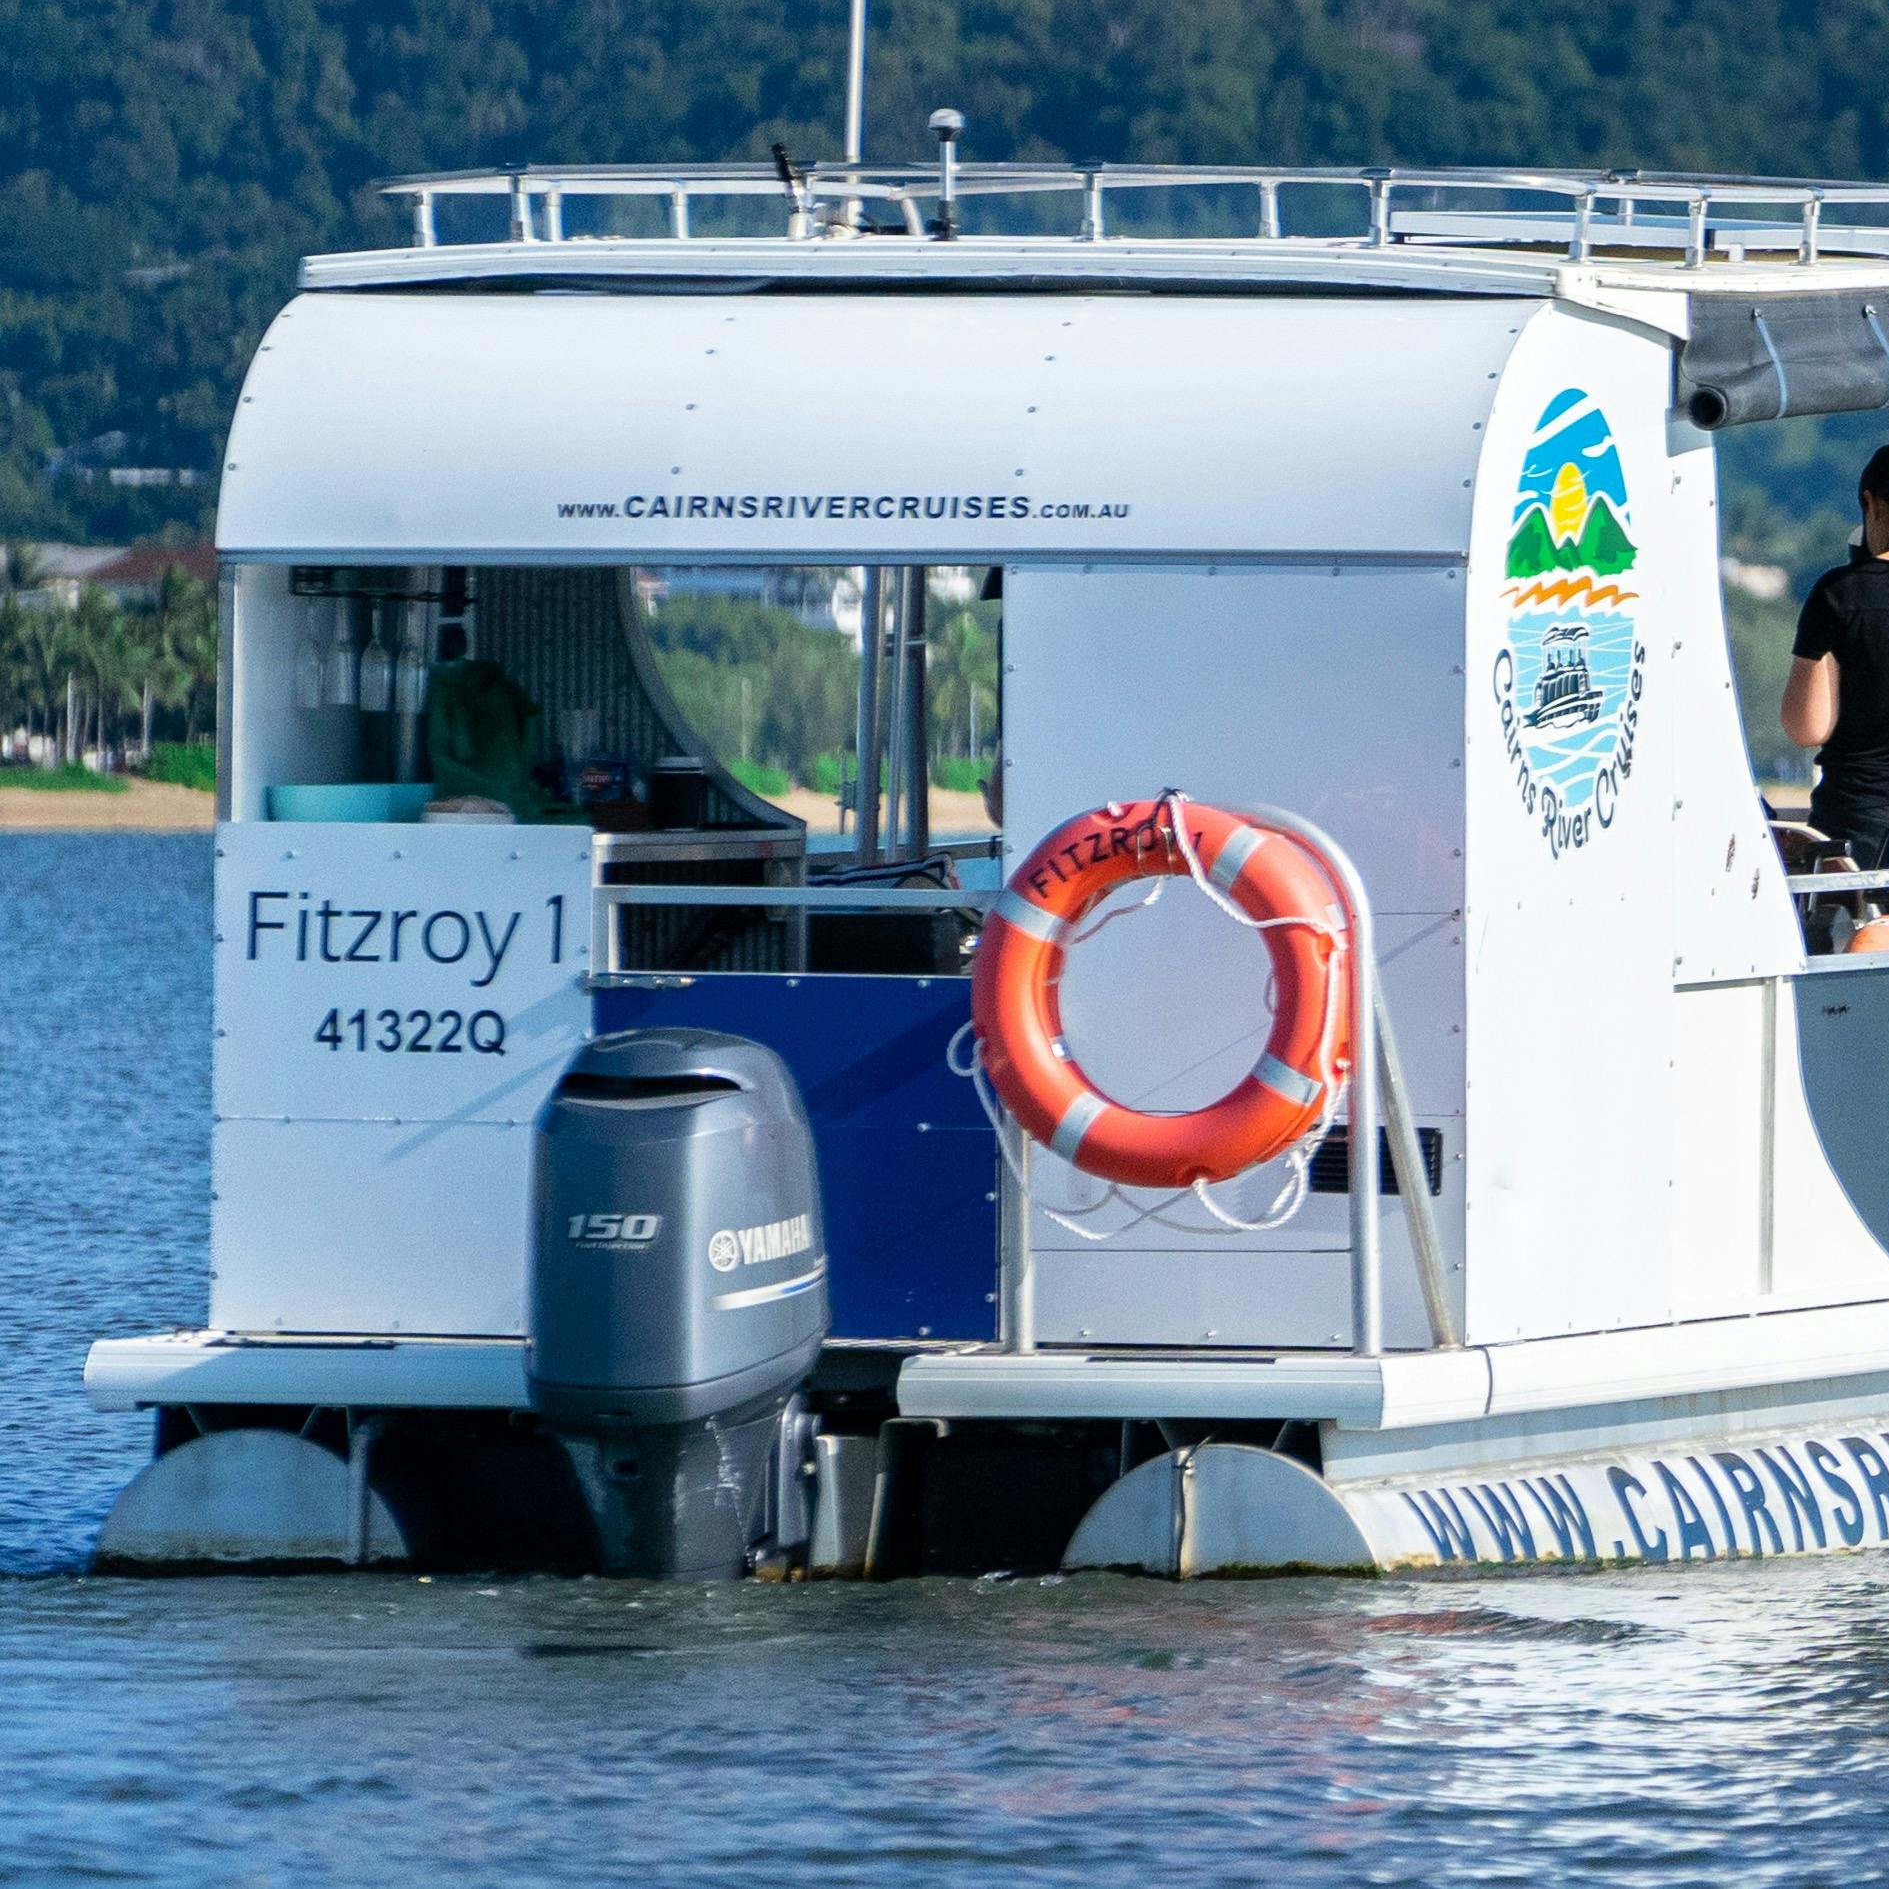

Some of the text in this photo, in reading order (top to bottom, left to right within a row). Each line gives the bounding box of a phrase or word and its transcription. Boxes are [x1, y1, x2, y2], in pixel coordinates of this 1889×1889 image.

[1492, 640, 1646, 861] Cairns River Cruises
[246, 891, 564, 987] Fitzroy 1
[314, 1008, 506, 1056] 41322Q
[567, 1214, 660, 1241] 150
[738, 1213, 811, 1265] YAMAHA
